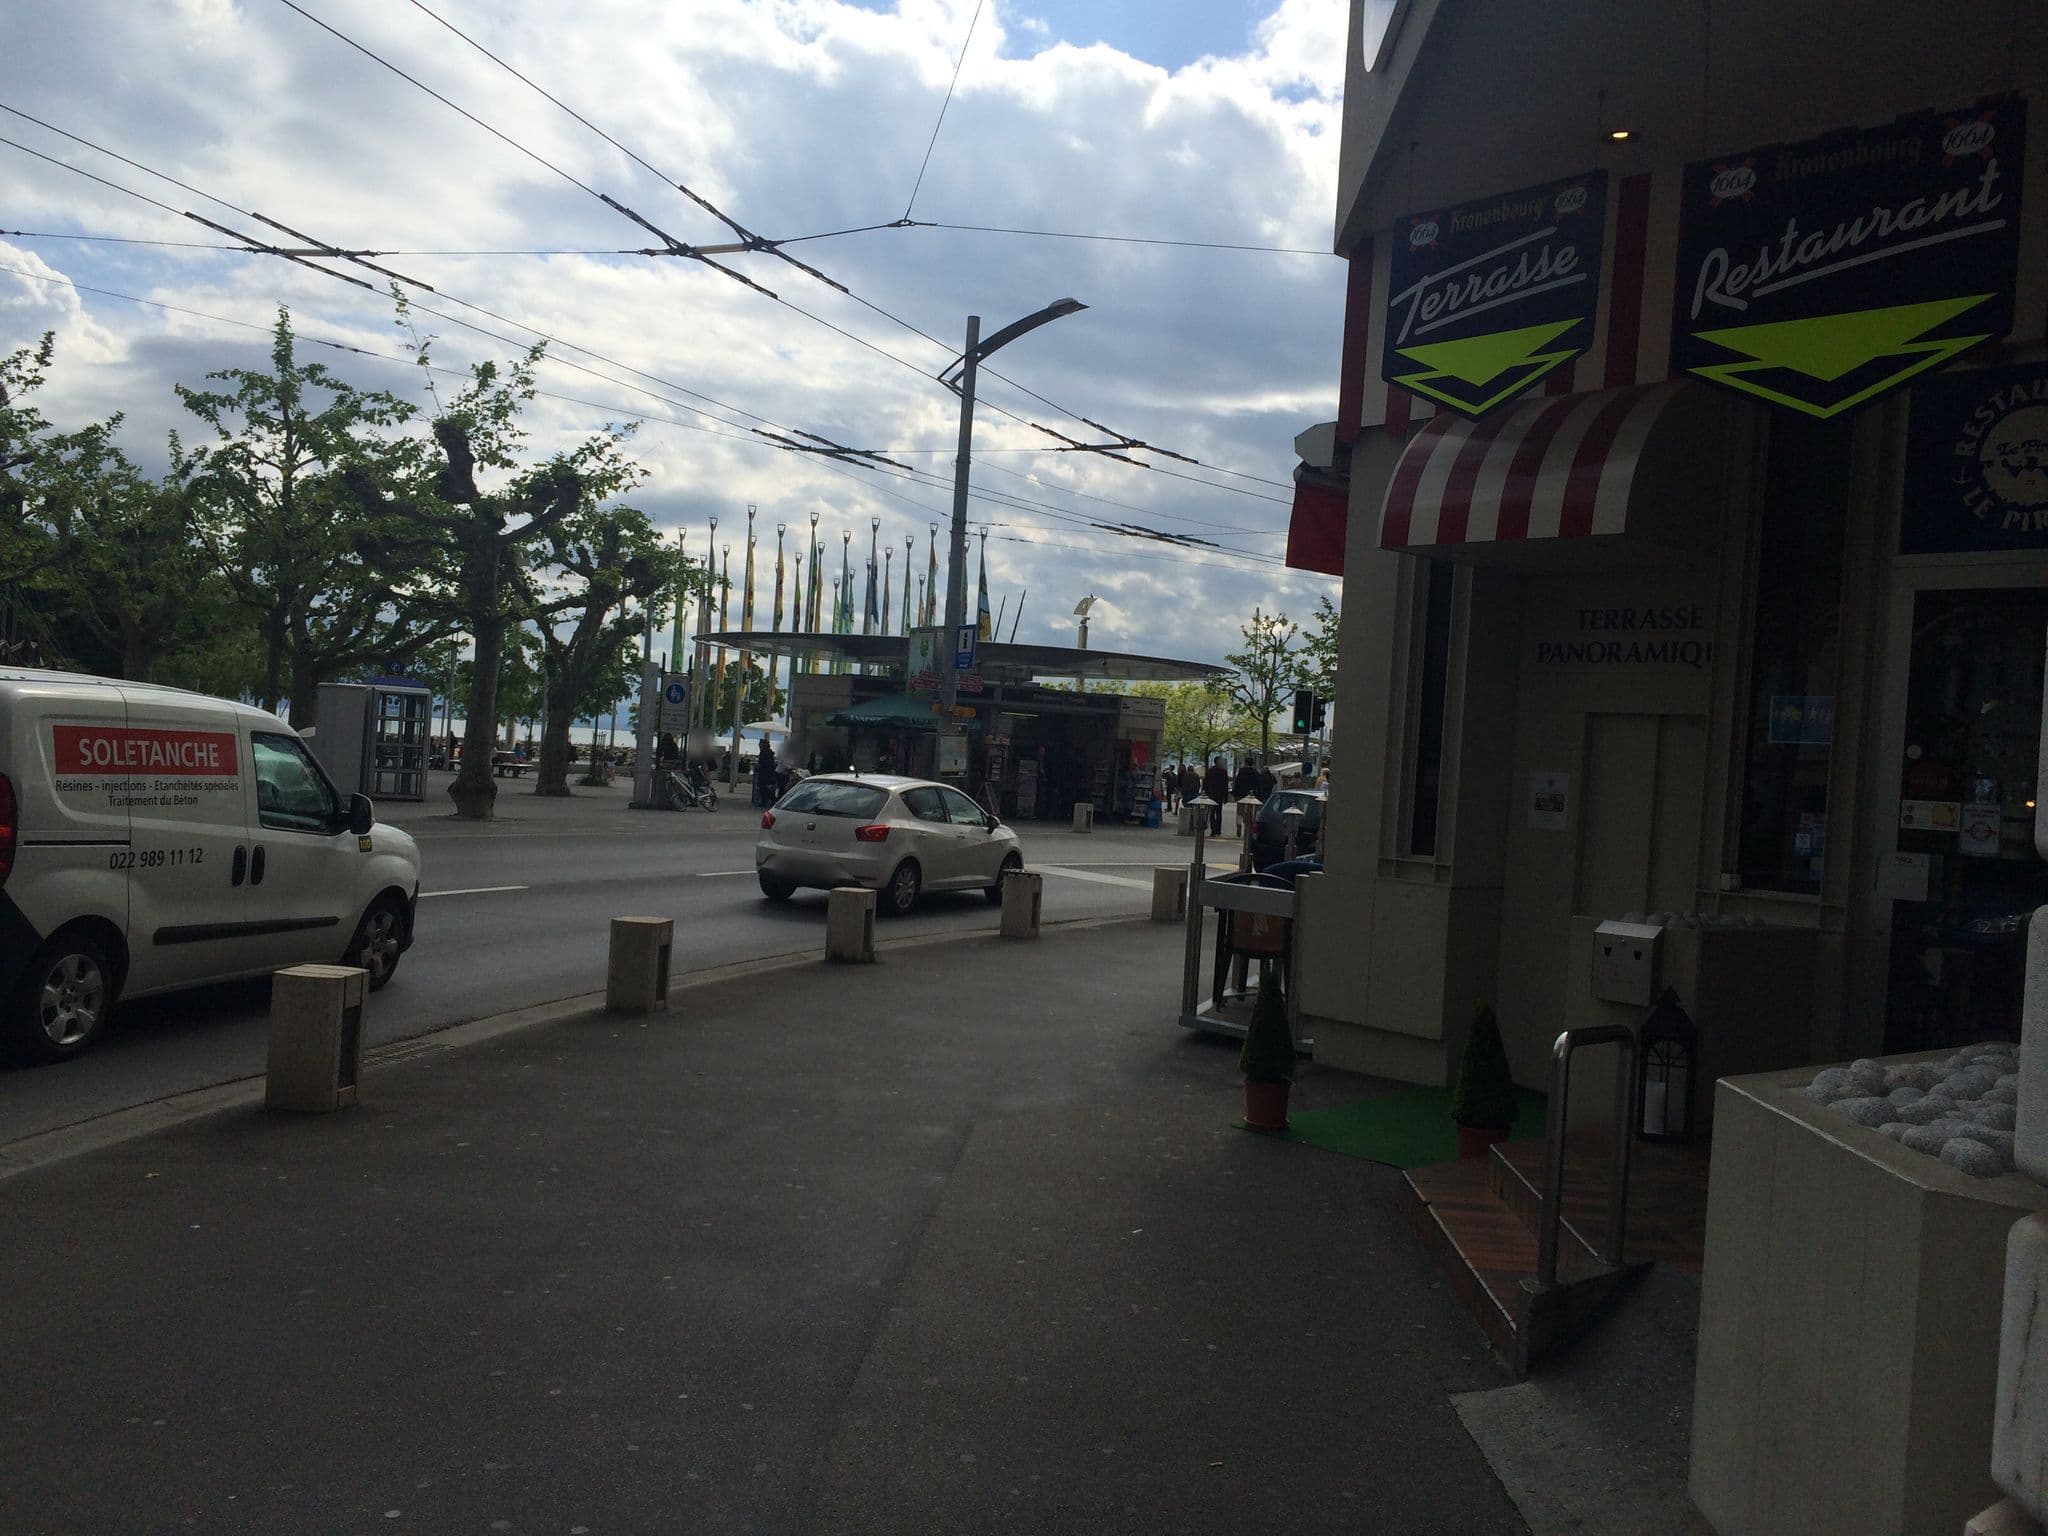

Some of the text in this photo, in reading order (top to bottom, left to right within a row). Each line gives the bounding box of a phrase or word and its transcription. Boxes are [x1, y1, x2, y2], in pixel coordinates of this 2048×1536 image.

[1690, 158, 2003, 320] Restaurant
[1391, 226, 1580, 344] Terrasse
[1577, 608, 1704, 630] TERRASSE
[79, 738, 220, 768] SOLETANCHE
[102, 780, 146, 792] injections
[108, 795, 158, 807] Traitement
[160, 794, 172, 806] du
[110, 847, 203, 869] 022 989 11 12
